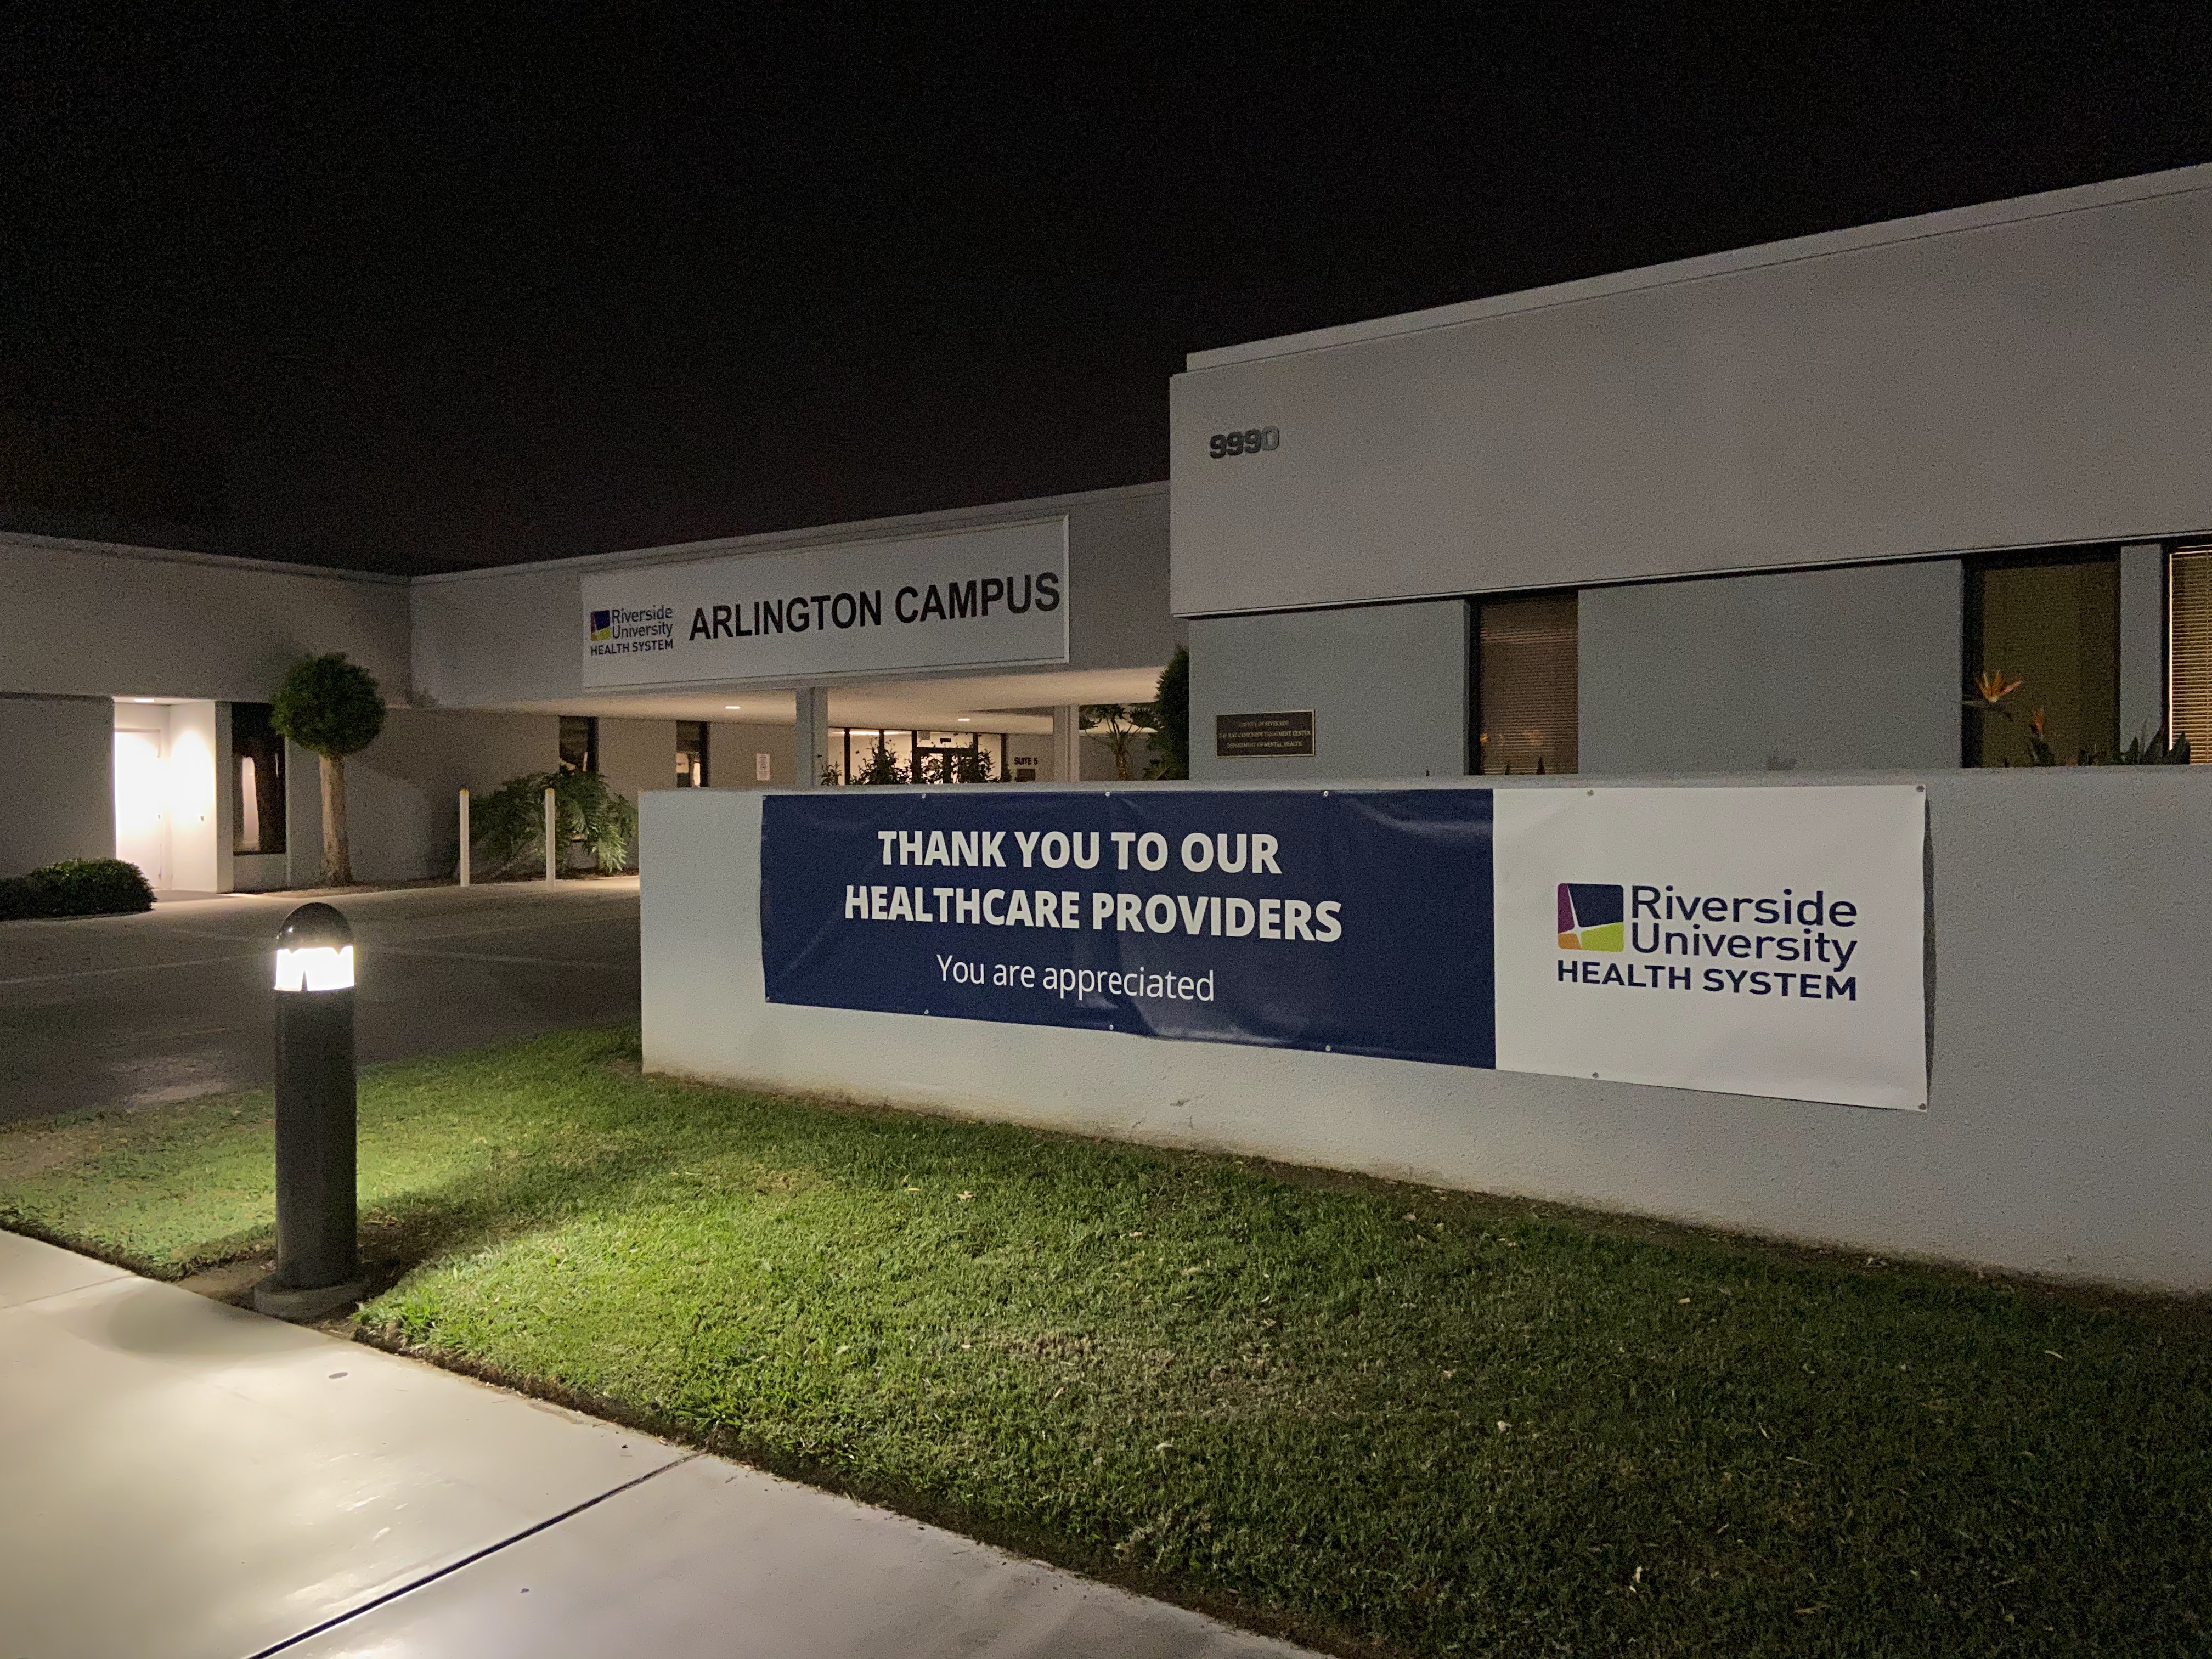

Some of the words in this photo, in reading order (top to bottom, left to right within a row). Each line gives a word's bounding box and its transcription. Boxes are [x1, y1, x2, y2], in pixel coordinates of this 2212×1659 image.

[1210, 426, 1280, 459] 9990
[612, 605, 673, 624] Riverside
[689, 590, 881, 641] ARLINGTON
[895, 572, 1060, 624] CAMPUS
[591, 642, 629, 656] HEALTH
[633, 639, 673, 652] SYSTEM
[612, 622, 673, 639] University
[878, 830, 1005, 868] THANK
[1014, 831, 1099, 870] YOU
[1111, 832, 1168, 871] TO
[1181, 832, 1282, 874] OUR
[845, 885, 1080, 929] HEALTHCARE
[1092, 892, 1342, 943] PROVIDERS
[1632, 885, 1857, 927] Riverside
[1632, 922, 1858, 972] University
[936, 954, 985, 985] You
[994, 962, 1035, 988] are
[1043, 967, 1214, 1001] appreciated
[1558, 960, 1691, 990] HEALTH
[1703, 968, 1857, 1001] SYSTEM
